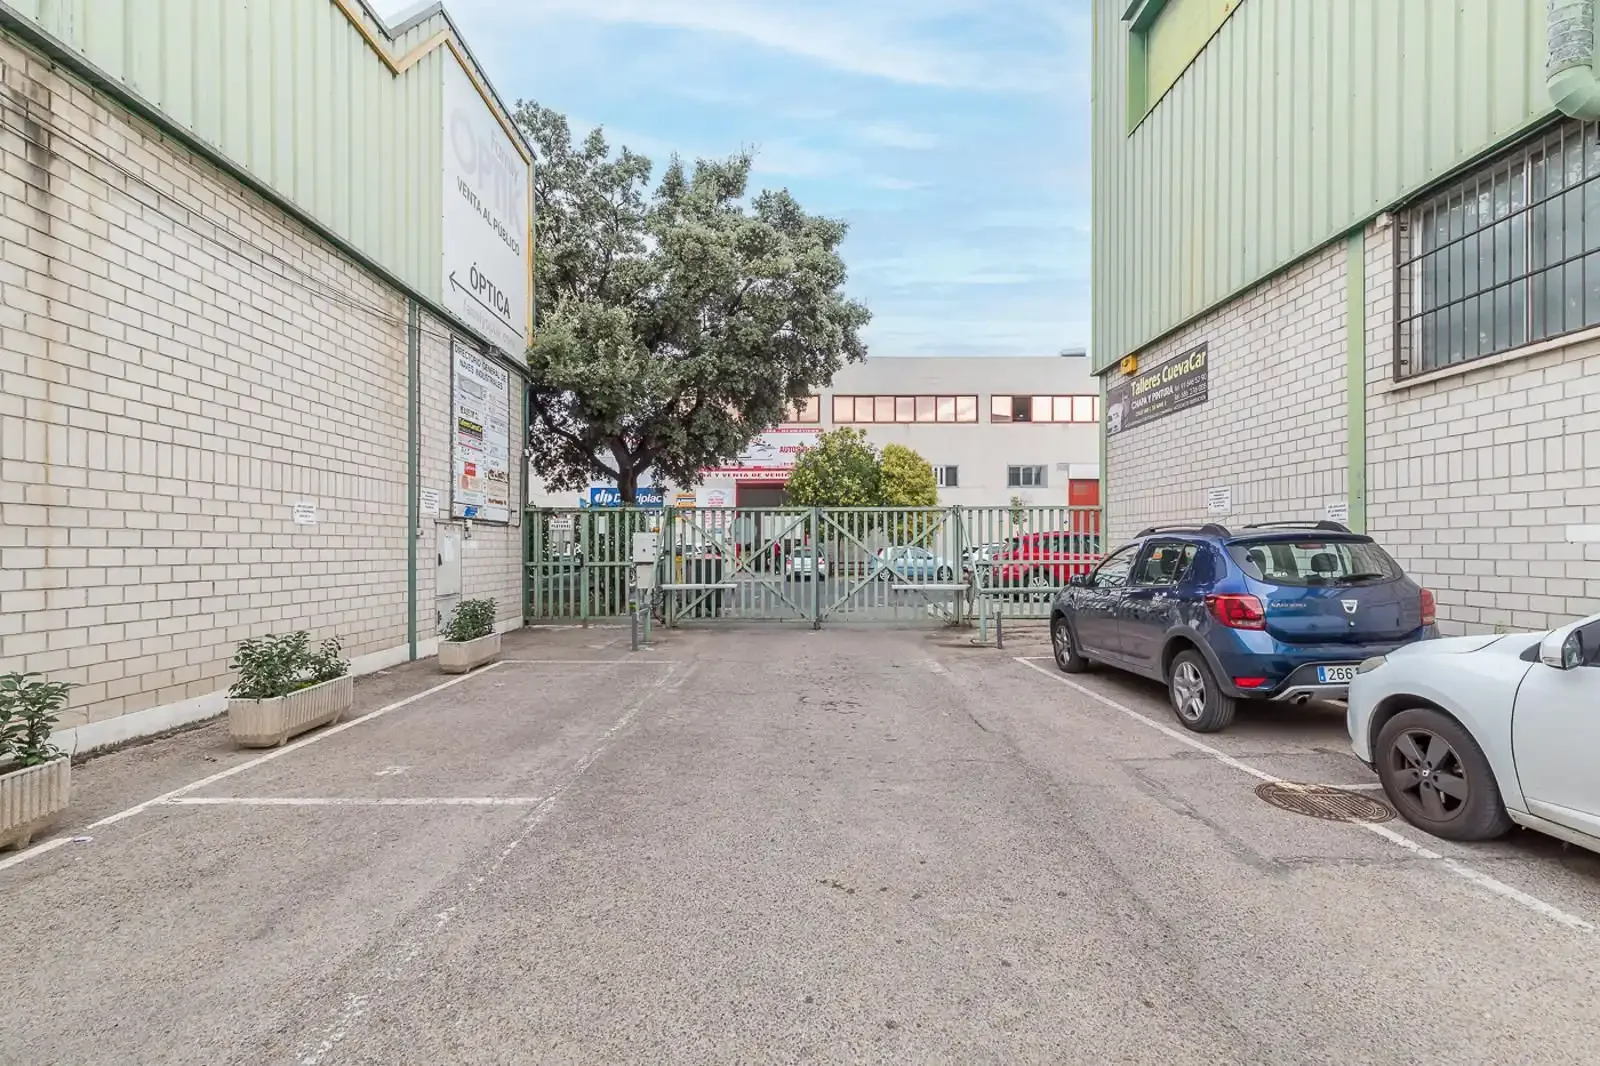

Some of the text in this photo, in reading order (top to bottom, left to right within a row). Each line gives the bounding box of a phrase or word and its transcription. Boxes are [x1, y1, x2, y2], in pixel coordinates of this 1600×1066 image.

[456, 175, 520, 257] VENTA AL PÚBLICO
[469, 261, 511, 320] ÓPTICA
[454, 343, 506, 383] DIRECTORIO GENERAL DE
[459, 358, 504, 391] NAVES INDUSTRIALES
[1130, 350, 1207, 397] Talleres CuevaCar
[1131, 397, 1148, 410] CHAPA
[1151, 384, 1175, 402] PINTURA
